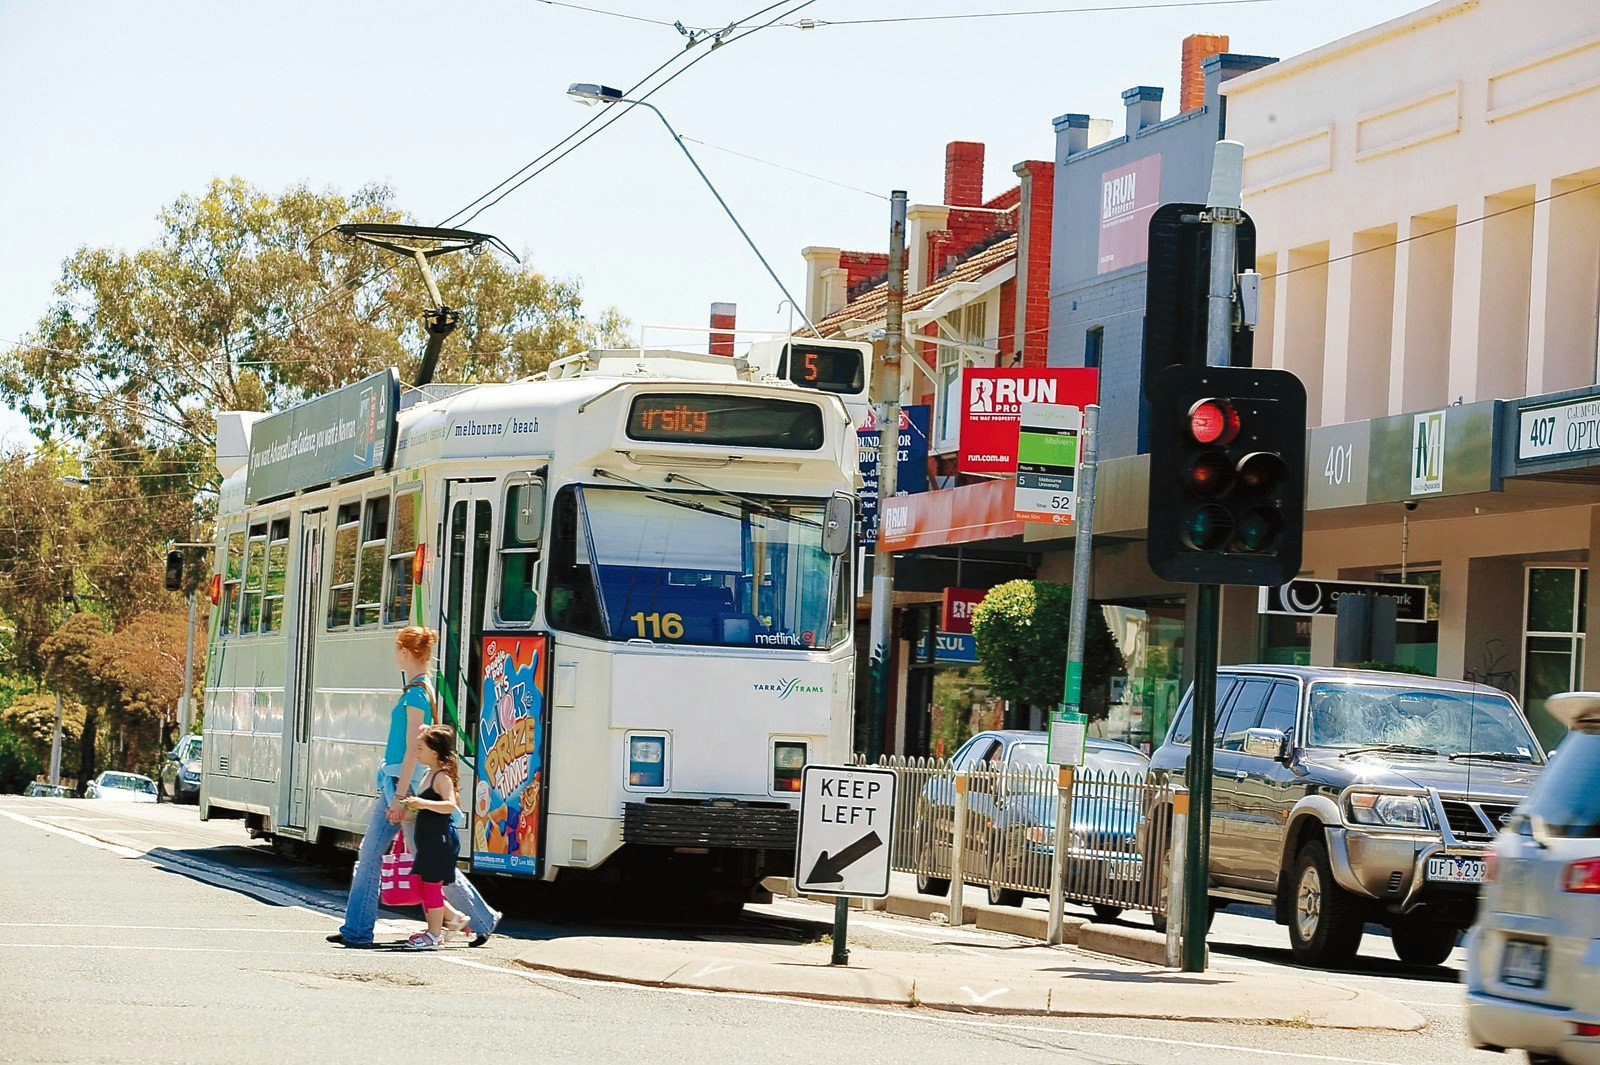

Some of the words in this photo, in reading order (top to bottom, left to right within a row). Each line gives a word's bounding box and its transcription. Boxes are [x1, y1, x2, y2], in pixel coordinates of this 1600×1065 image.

[1113, 172, 1136, 207] RUN
[804, 354, 818, 381] 5
[995, 378, 1057, 403] RUN
[995, 404, 1021, 413] PRO
[454, 420, 502, 437] melbourne
[512, 417, 539, 434] beach
[1530, 416, 1556, 447] 407
[1044, 437, 1074, 446] Malvern
[968, 455, 1010, 463] run.com.au
[1324, 443, 1353, 485] 401
[1018, 475, 1026, 486] 5
[1038, 476, 1062, 484] Melbourne
[1051, 496, 1070, 510] 52
[630, 611, 685, 639] 116
[754, 632, 801, 646] metlink
[753, 684, 782, 692] YARRA
[484, 716, 535, 789] PRIZE
[498, 755, 528, 801] TIME
[821, 778, 881, 800] KEEP
[821, 804, 877, 826] LEFT
[1430, 860, 1453, 876] UFI
[1464, 863, 1487, 878] 299
